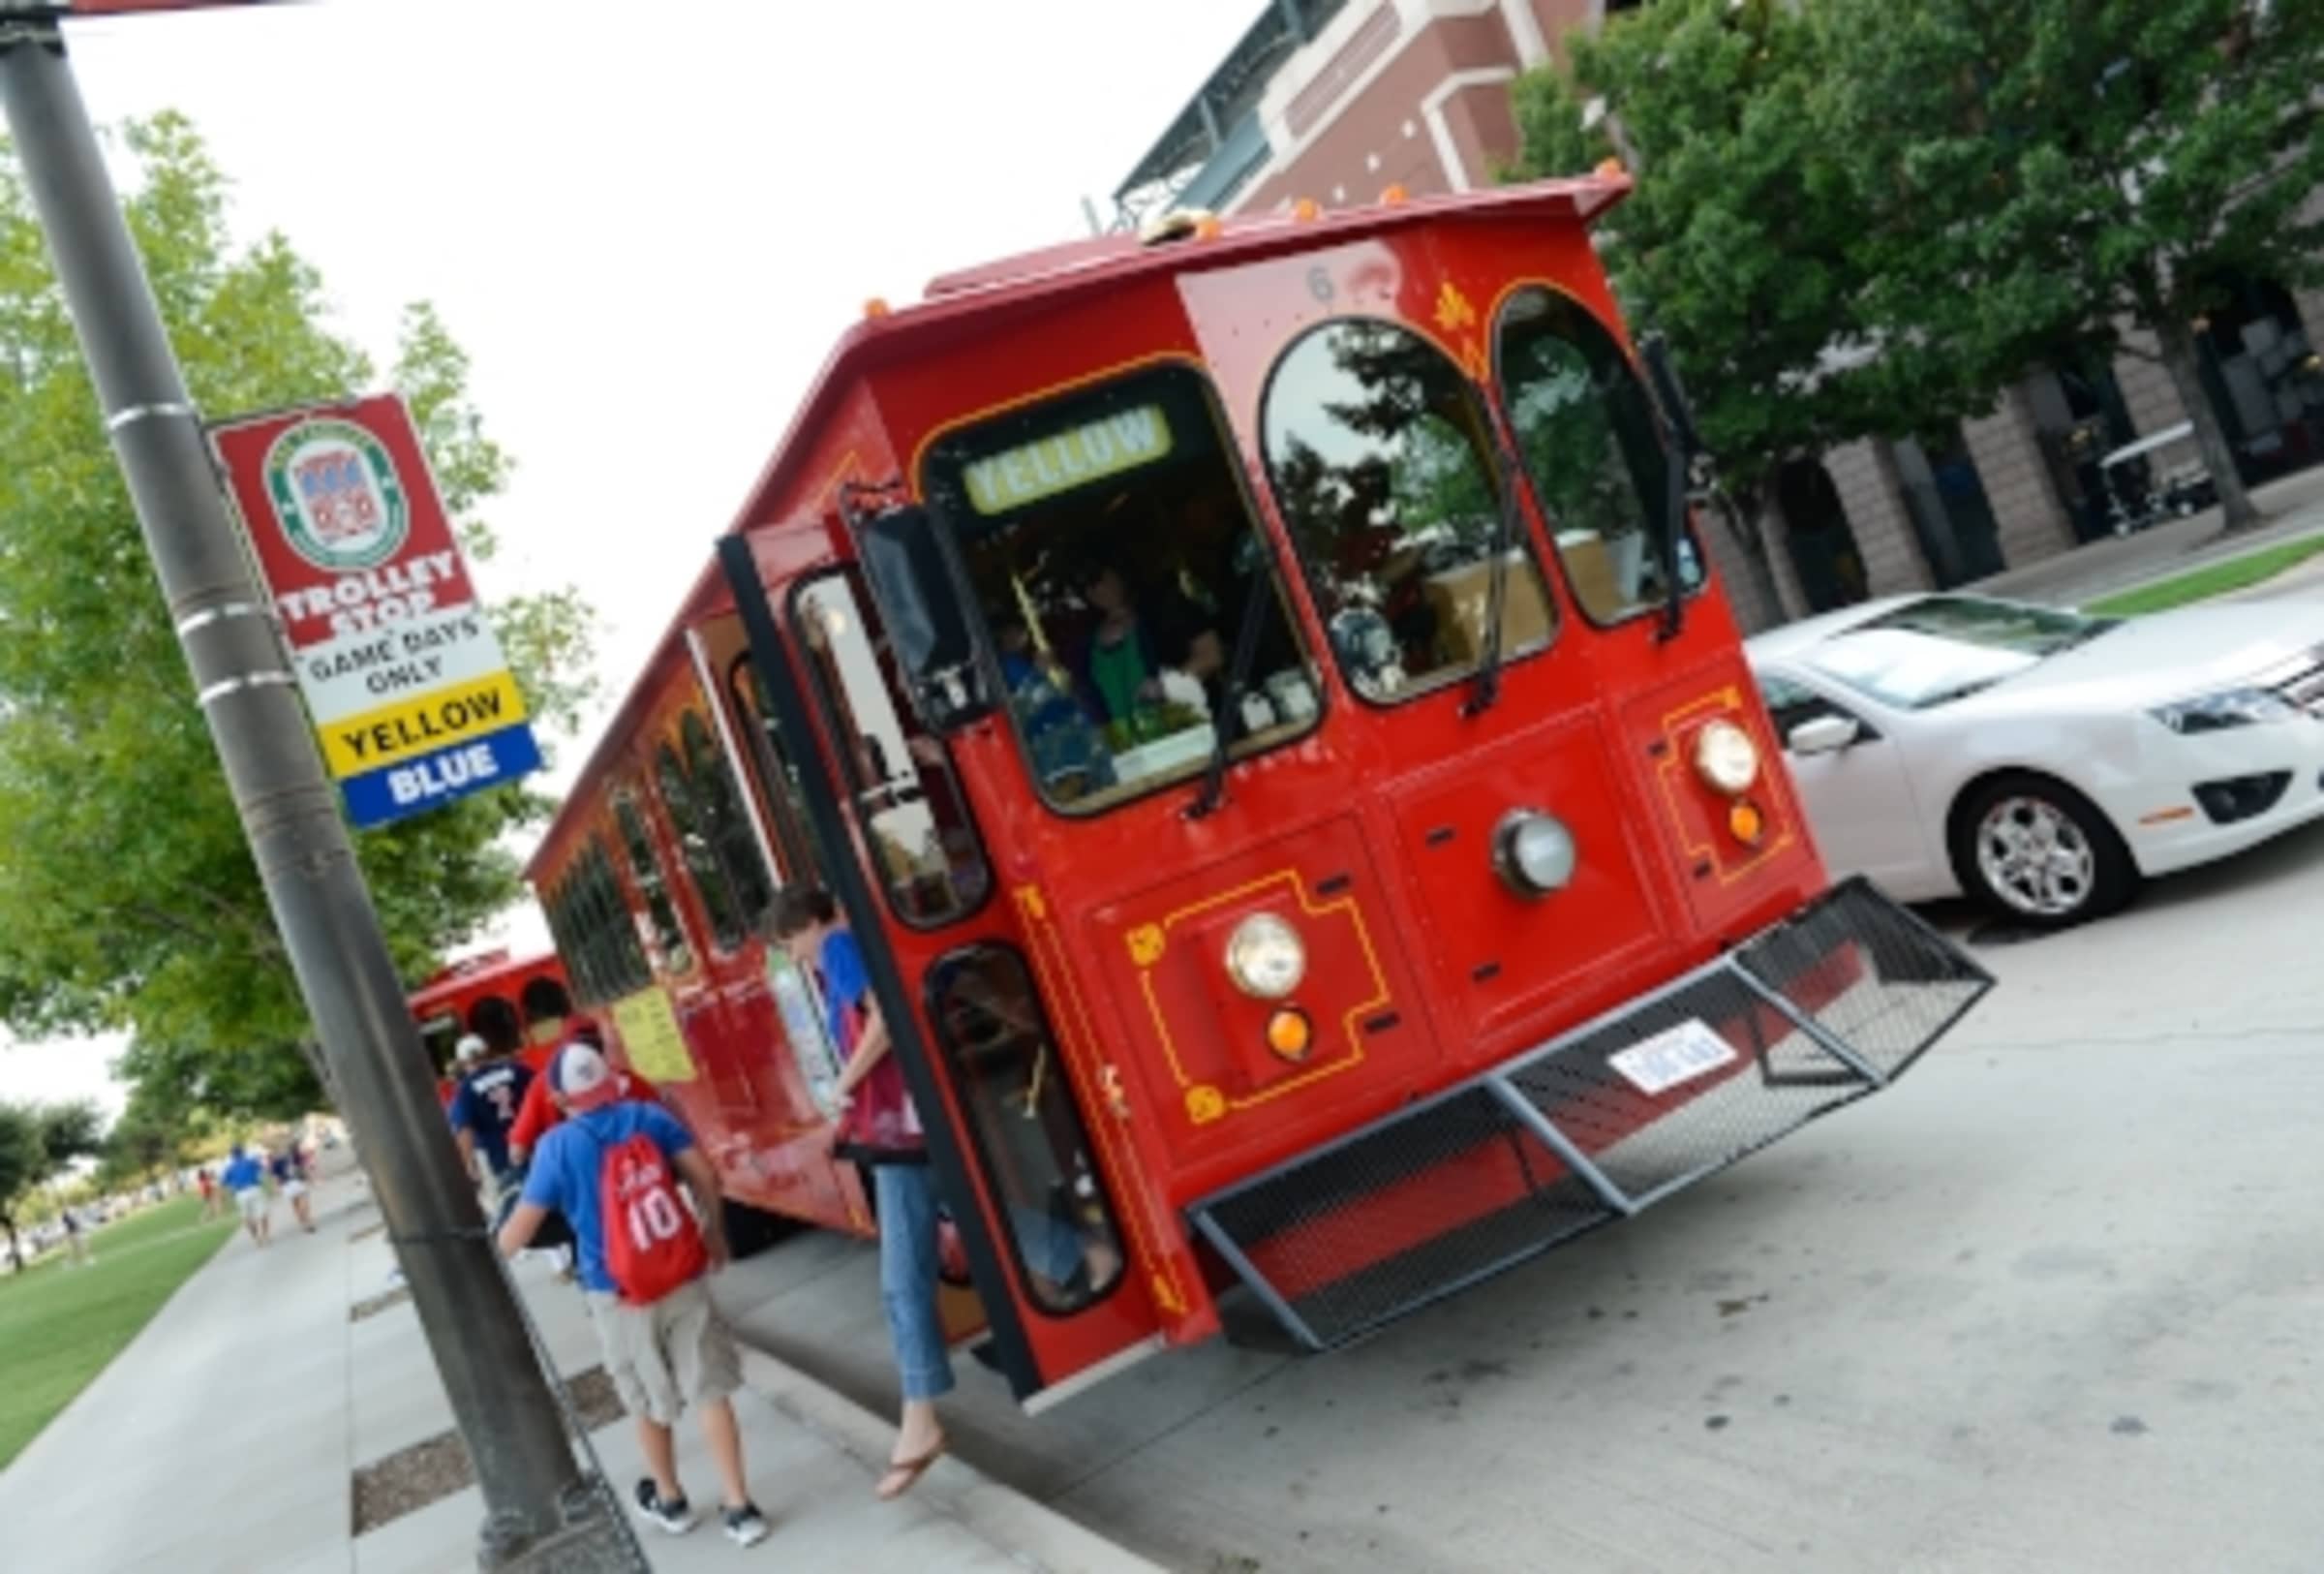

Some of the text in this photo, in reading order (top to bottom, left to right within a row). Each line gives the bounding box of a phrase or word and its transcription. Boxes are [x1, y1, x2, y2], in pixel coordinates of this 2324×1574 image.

[1307, 264, 1335, 304] 6
[966, 404, 1157, 504] YELLOW
[279, 550, 455, 622] TROLLEY
[329, 590, 436, 636] STOP
[309, 616, 479, 682] GAME DAYS
[366, 654, 443, 694] ONLY
[341, 689, 503, 759] YELLOW
[387, 743, 500, 805] BLUE
[627, 1188, 683, 1252] 10
